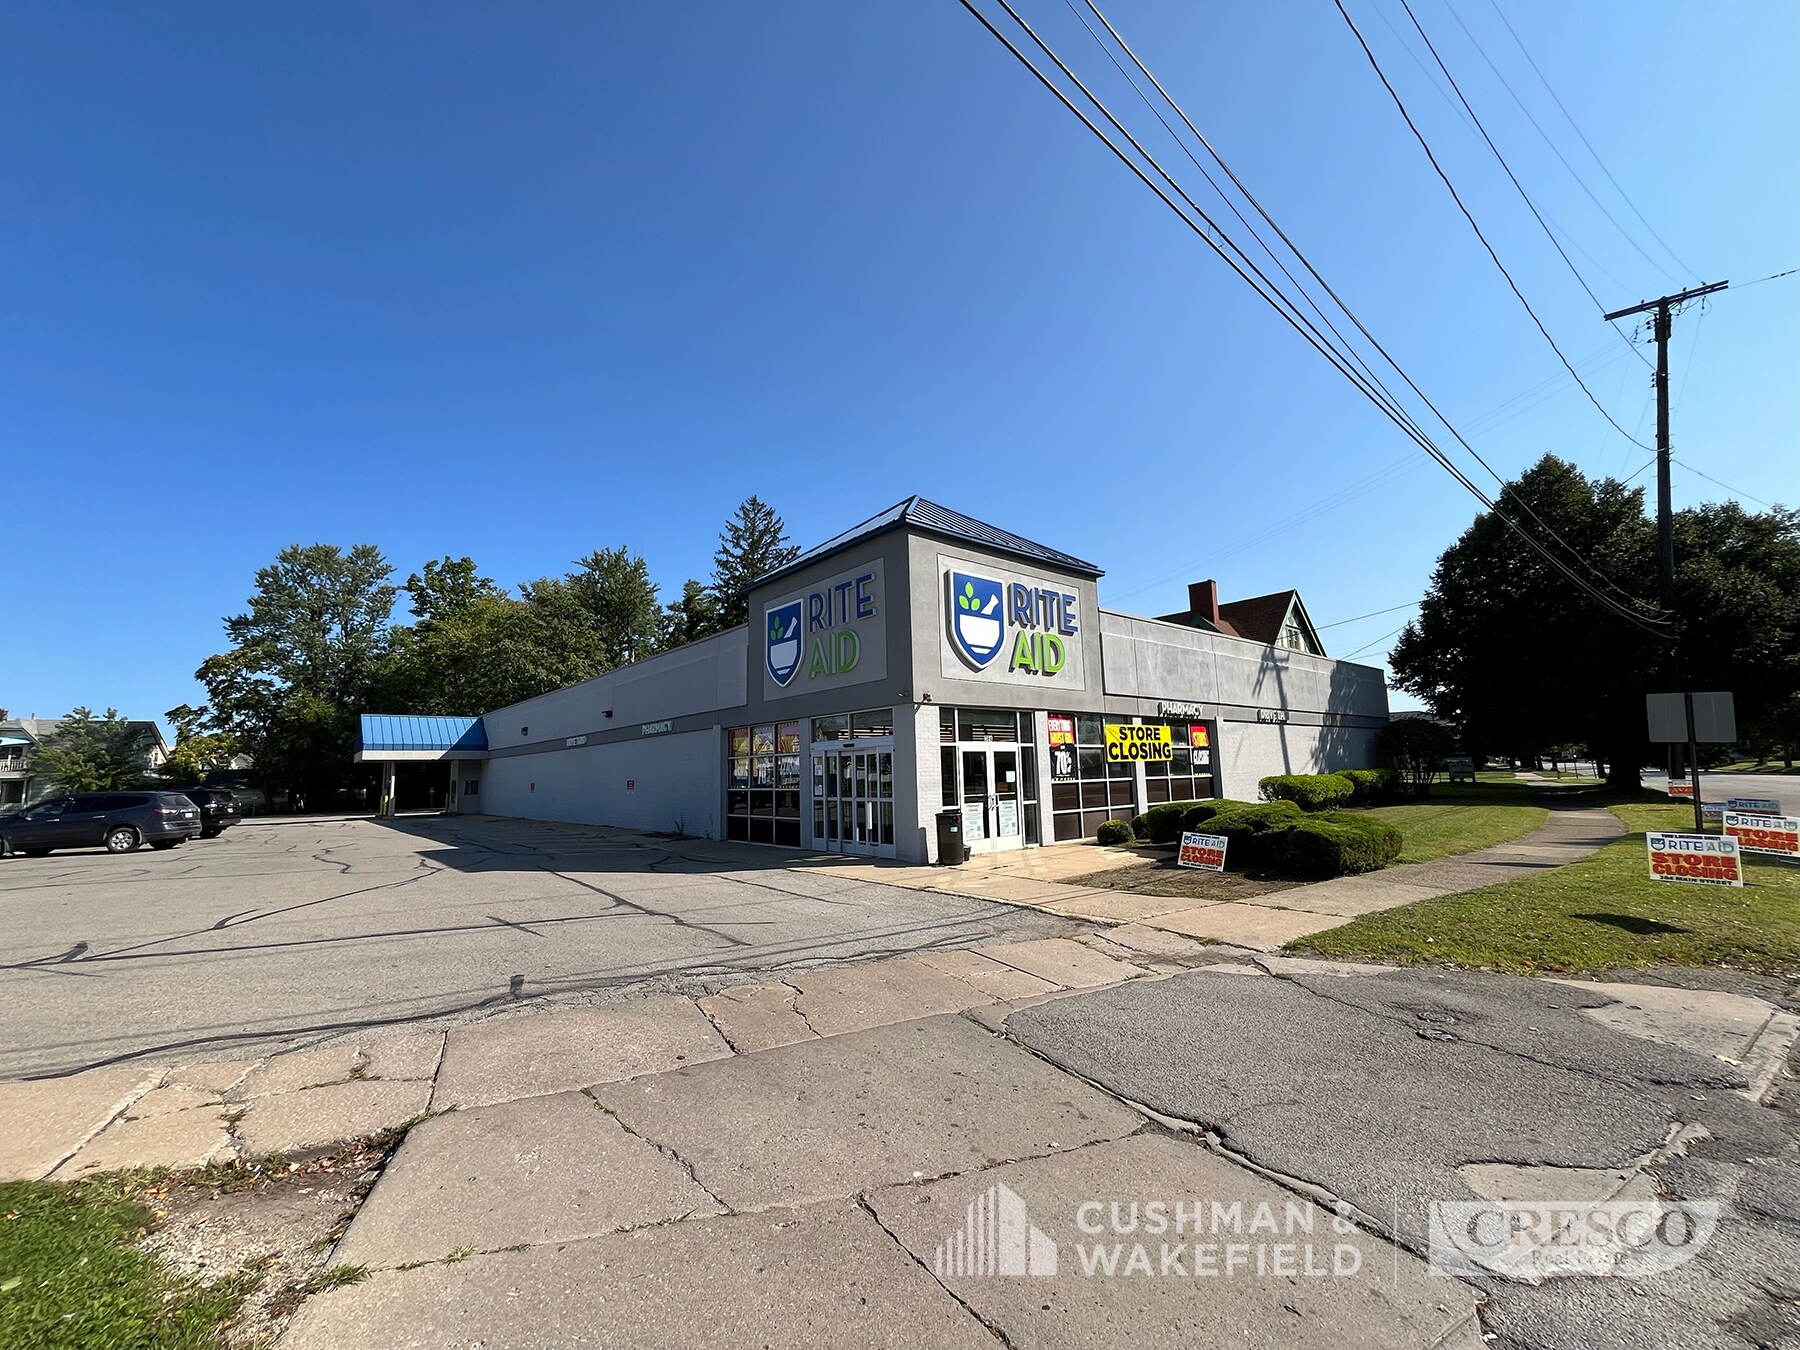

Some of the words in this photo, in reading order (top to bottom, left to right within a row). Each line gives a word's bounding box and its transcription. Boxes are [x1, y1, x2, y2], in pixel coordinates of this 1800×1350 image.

[808, 574, 877, 632] RITE
[1009, 582, 1078, 634] RITE
[808, 629, 861, 679] AID
[1012, 630, 1066, 673] AID
[1162, 701, 1204, 717] PHARMACY
[1119, 726, 1161, 741] STORE
[1108, 742, 1172, 760] CLOSING
[1741, 818, 1771, 828] RITE
[1773, 820, 1798, 831] AID
[1725, 827, 1798, 842] STORE
[1192, 838, 1210, 846] RITE
[1211, 840, 1225, 848] AID
[1668, 840, 1703, 851] RITE
[1706, 841, 1734, 853] AID
[1737, 837, 1799, 852] LOSING
[1181, 854, 1222, 866] CLOSING
[1182, 846, 1224, 859] STORE
[1651, 852, 1737, 868] STORE
[1652, 863, 1738, 880] CLOSING
